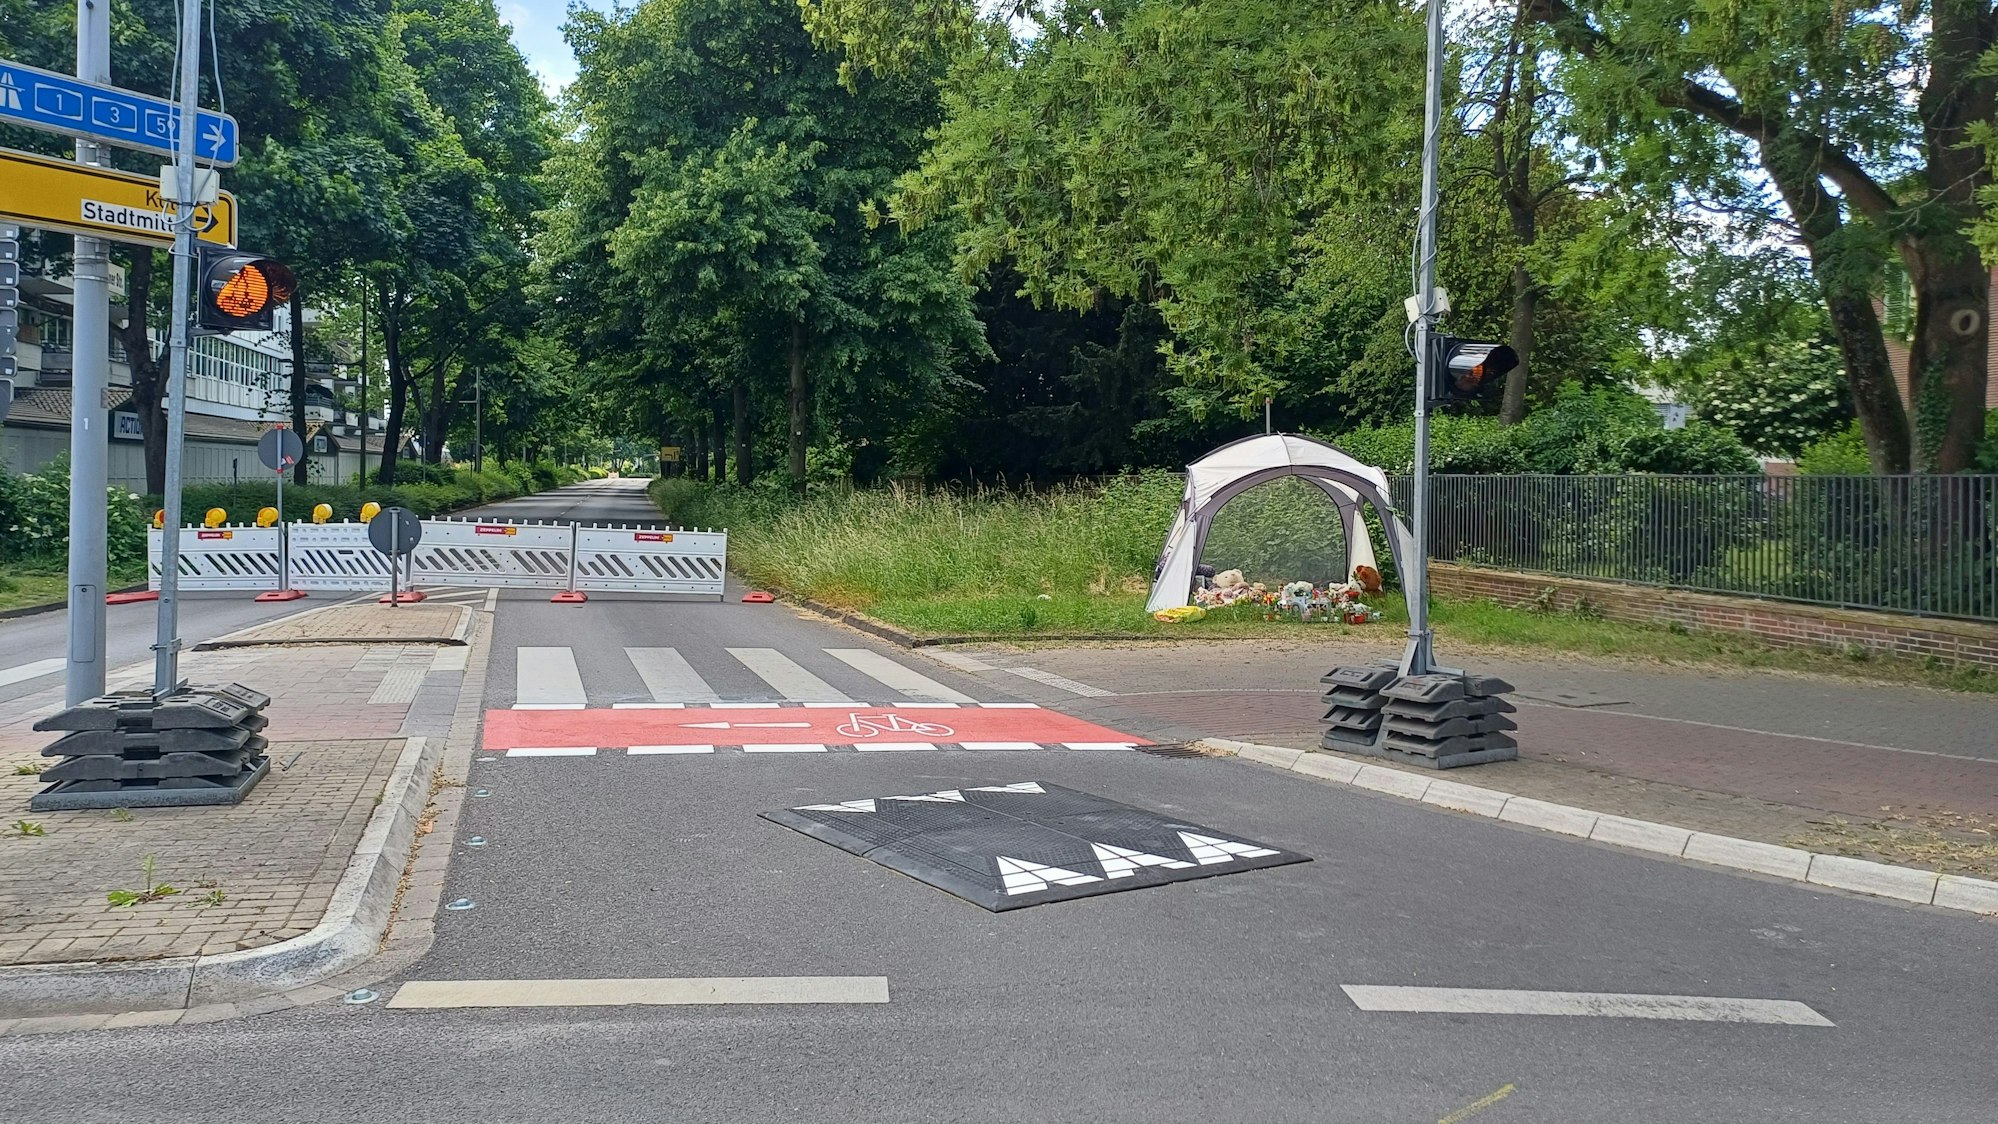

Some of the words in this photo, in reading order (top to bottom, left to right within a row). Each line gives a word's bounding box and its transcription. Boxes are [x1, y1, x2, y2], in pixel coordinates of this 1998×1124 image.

[56, 93, 63, 111] 1
[109, 106, 121, 124] 3
[83, 202, 177, 232] Stadtmitt
[83, 417, 89, 430] 1
[120, 415, 143, 434] ACTIO
